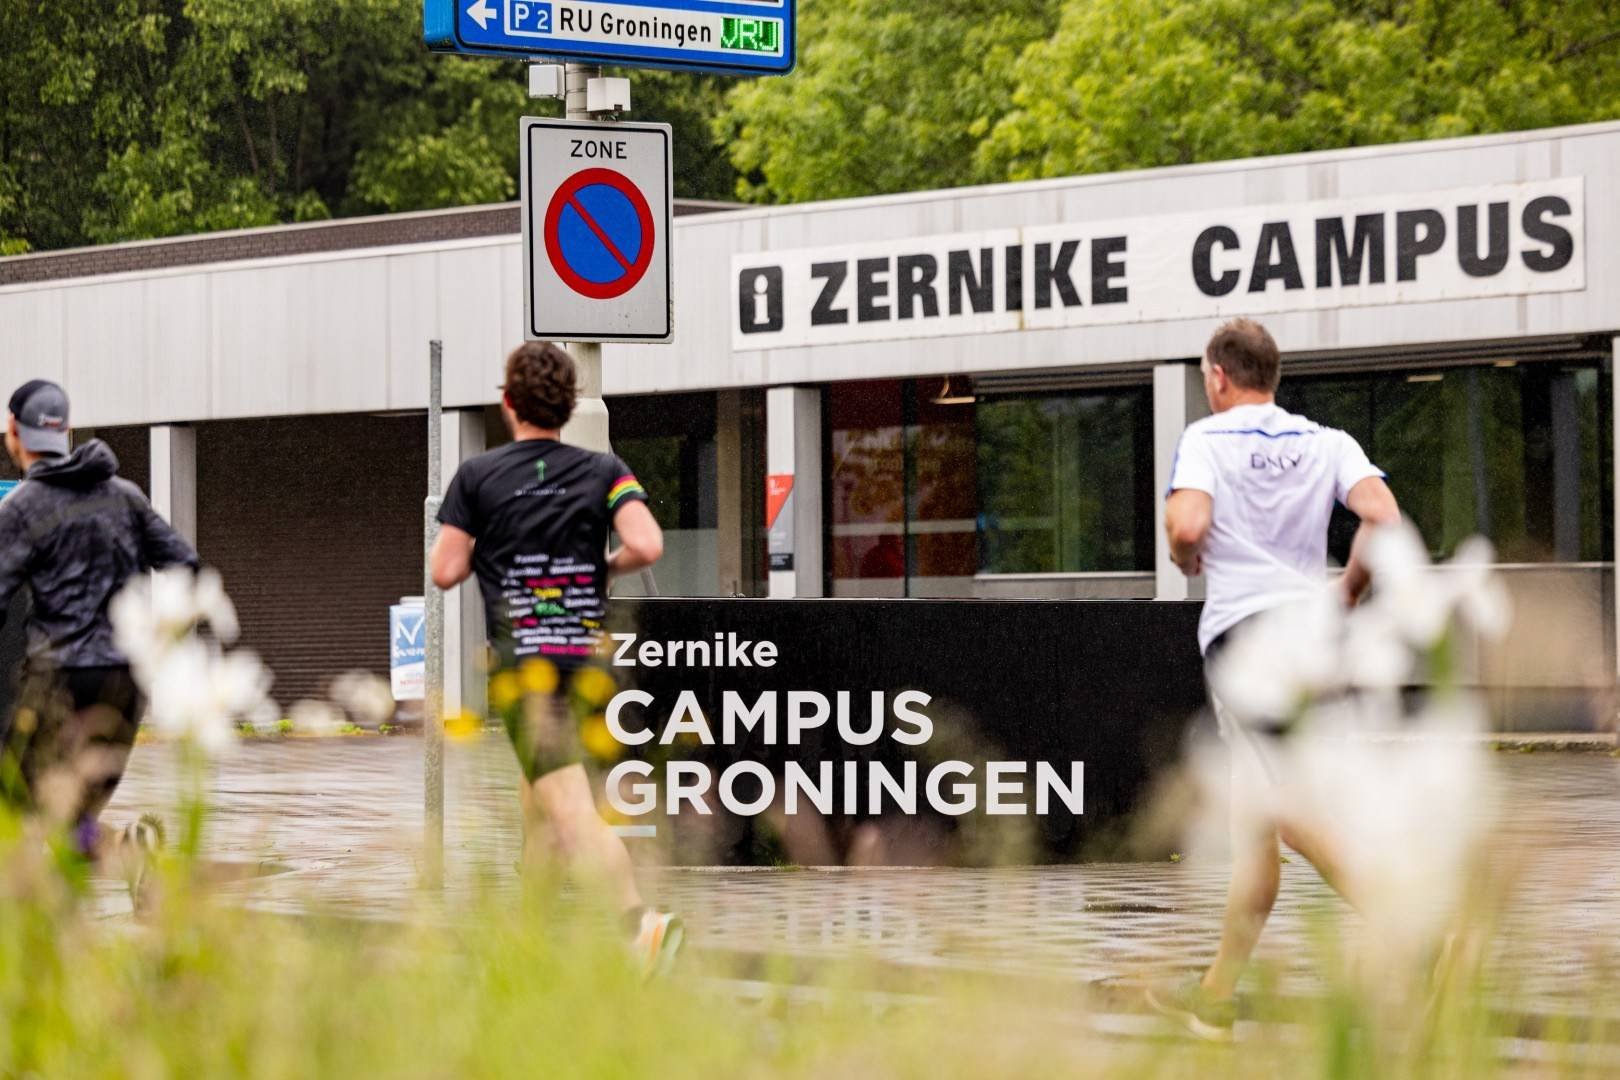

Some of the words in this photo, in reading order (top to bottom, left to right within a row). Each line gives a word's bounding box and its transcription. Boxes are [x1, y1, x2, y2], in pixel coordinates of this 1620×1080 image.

[560, 7, 592, 33] RU
[600, 12, 711, 47] Groningen
[570, 139, 627, 159] ZONE
[811, 236, 1128, 326] ZERNIKE
[1192, 196, 1574, 297] CAMPUS
[612, 632, 778, 667] Zernike
[605, 690, 934, 745] CAMPUS
[605, 760, 1084, 816] GRONINGEN
